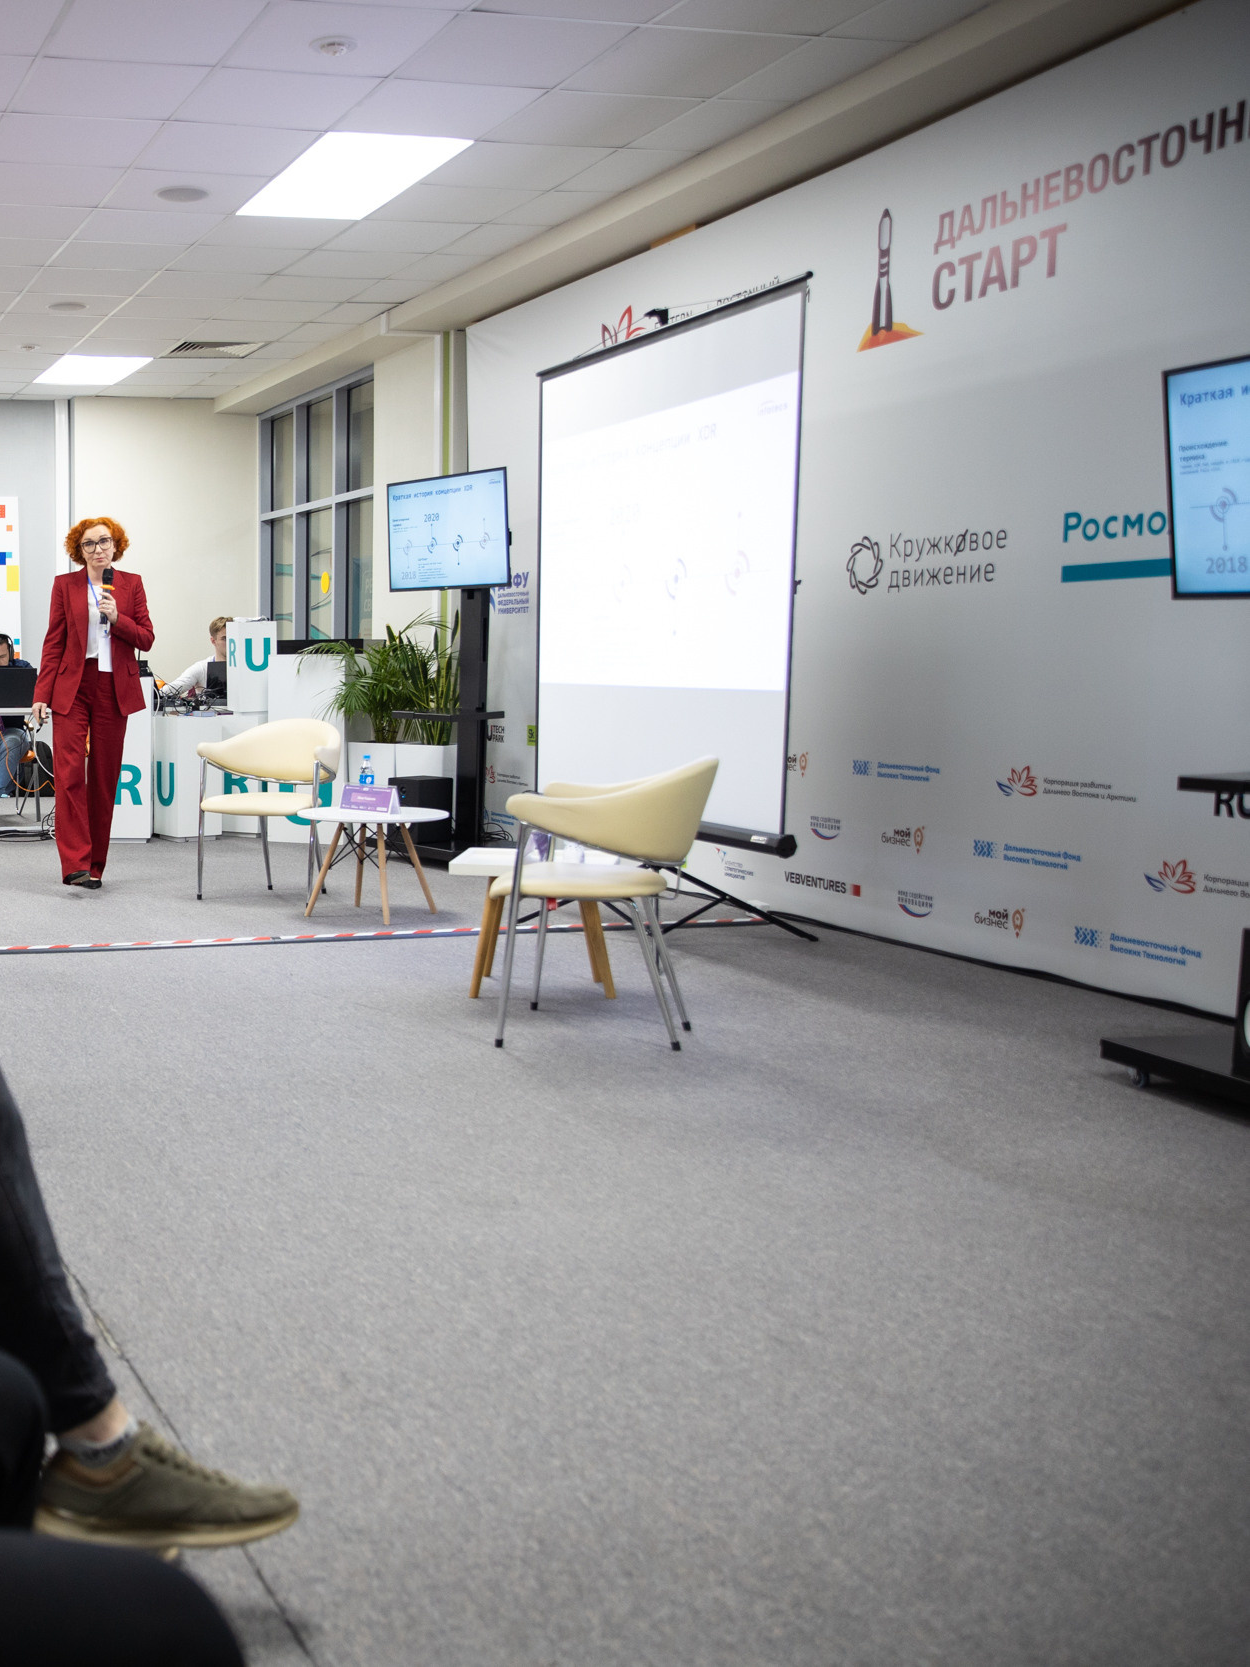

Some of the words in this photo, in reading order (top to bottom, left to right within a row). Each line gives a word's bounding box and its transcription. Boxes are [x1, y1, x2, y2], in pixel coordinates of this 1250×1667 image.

[933, 99, 1250, 255] ДАЛЬНЕВОСТОЧН
[932, 223, 1068, 311] СТАРТ
[1179, 385, 1233, 408] Краткая
[1241, 384, 1250, 397] и
[393, 494, 411, 502] Краткая
[435, 487, 461, 495] концепции
[424, 513, 439, 522] 2020
[1062, 511, 1170, 543] Росмо
[1206, 556, 1248, 574] 2018
[887, 562, 995, 593] движение
[925, 765, 940, 774] Фонд
[1043, 777, 1079, 788] Корпорация
[1080, 780, 1111, 790] развития
[1043, 788, 1070, 796] Дальнего
[1072, 790, 1099, 799] Востока
[1106, 793, 1136, 802] Арктики
[881, 832, 910, 847] бизнес
[894, 828, 910, 838] мой
[1004, 844, 1061, 858] Дальневосточный
[1062, 851, 1081, 862] Фонд
[1004, 854, 1030, 864] Высоких
[1031, 858, 1068, 870] Технологий
[784, 871, 846, 894] VEBVENTURES
[1203, 874, 1249, 887] Корпорация
[1203, 885, 1238, 897] Дальнего
[898, 896, 933, 908] ИННОВАЦИЯМ
[974, 912, 1008, 930] бизнес
[989, 908, 1008, 920] мой
[1110, 932, 1178, 953] Дальневосточный
[1179, 944, 1201, 959] Фонд
[1110, 944, 1141, 958] Высоких
[1143, 949, 1186, 966] Технологий
